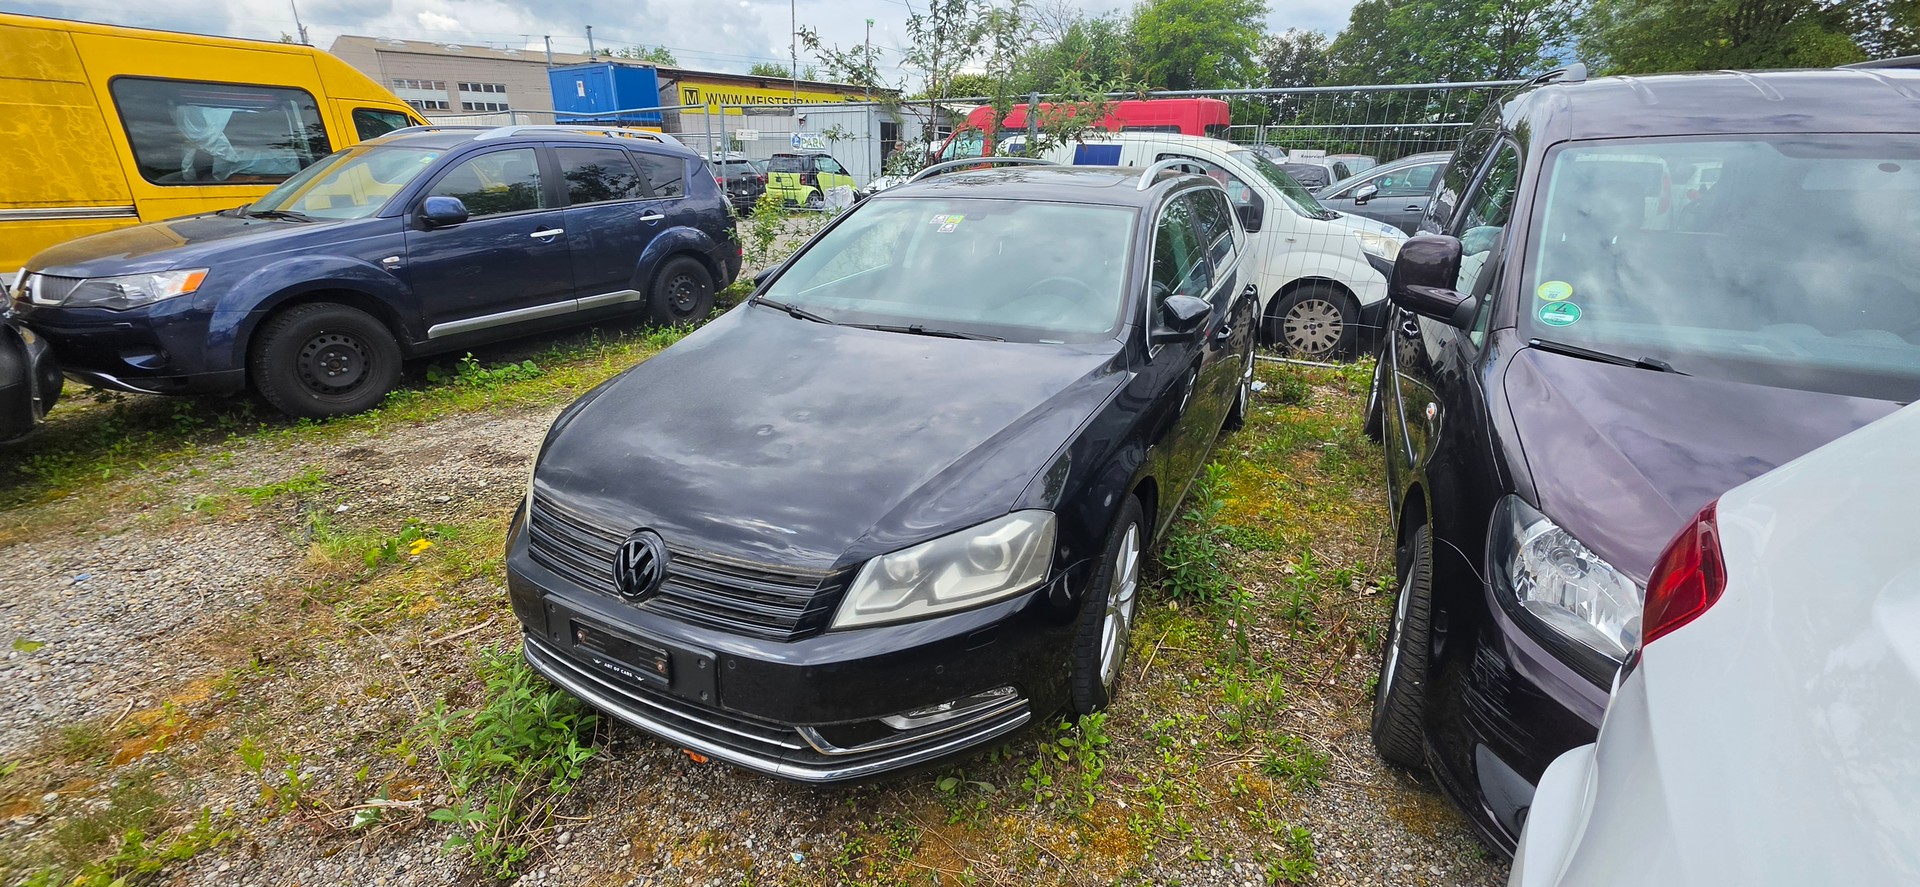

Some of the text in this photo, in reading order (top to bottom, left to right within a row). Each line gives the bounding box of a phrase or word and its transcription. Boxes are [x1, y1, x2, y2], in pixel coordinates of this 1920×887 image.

[801, 137, 825, 149] PARK
[604, 662, 613, 670] ART
[620, 669, 633, 678] CARS
